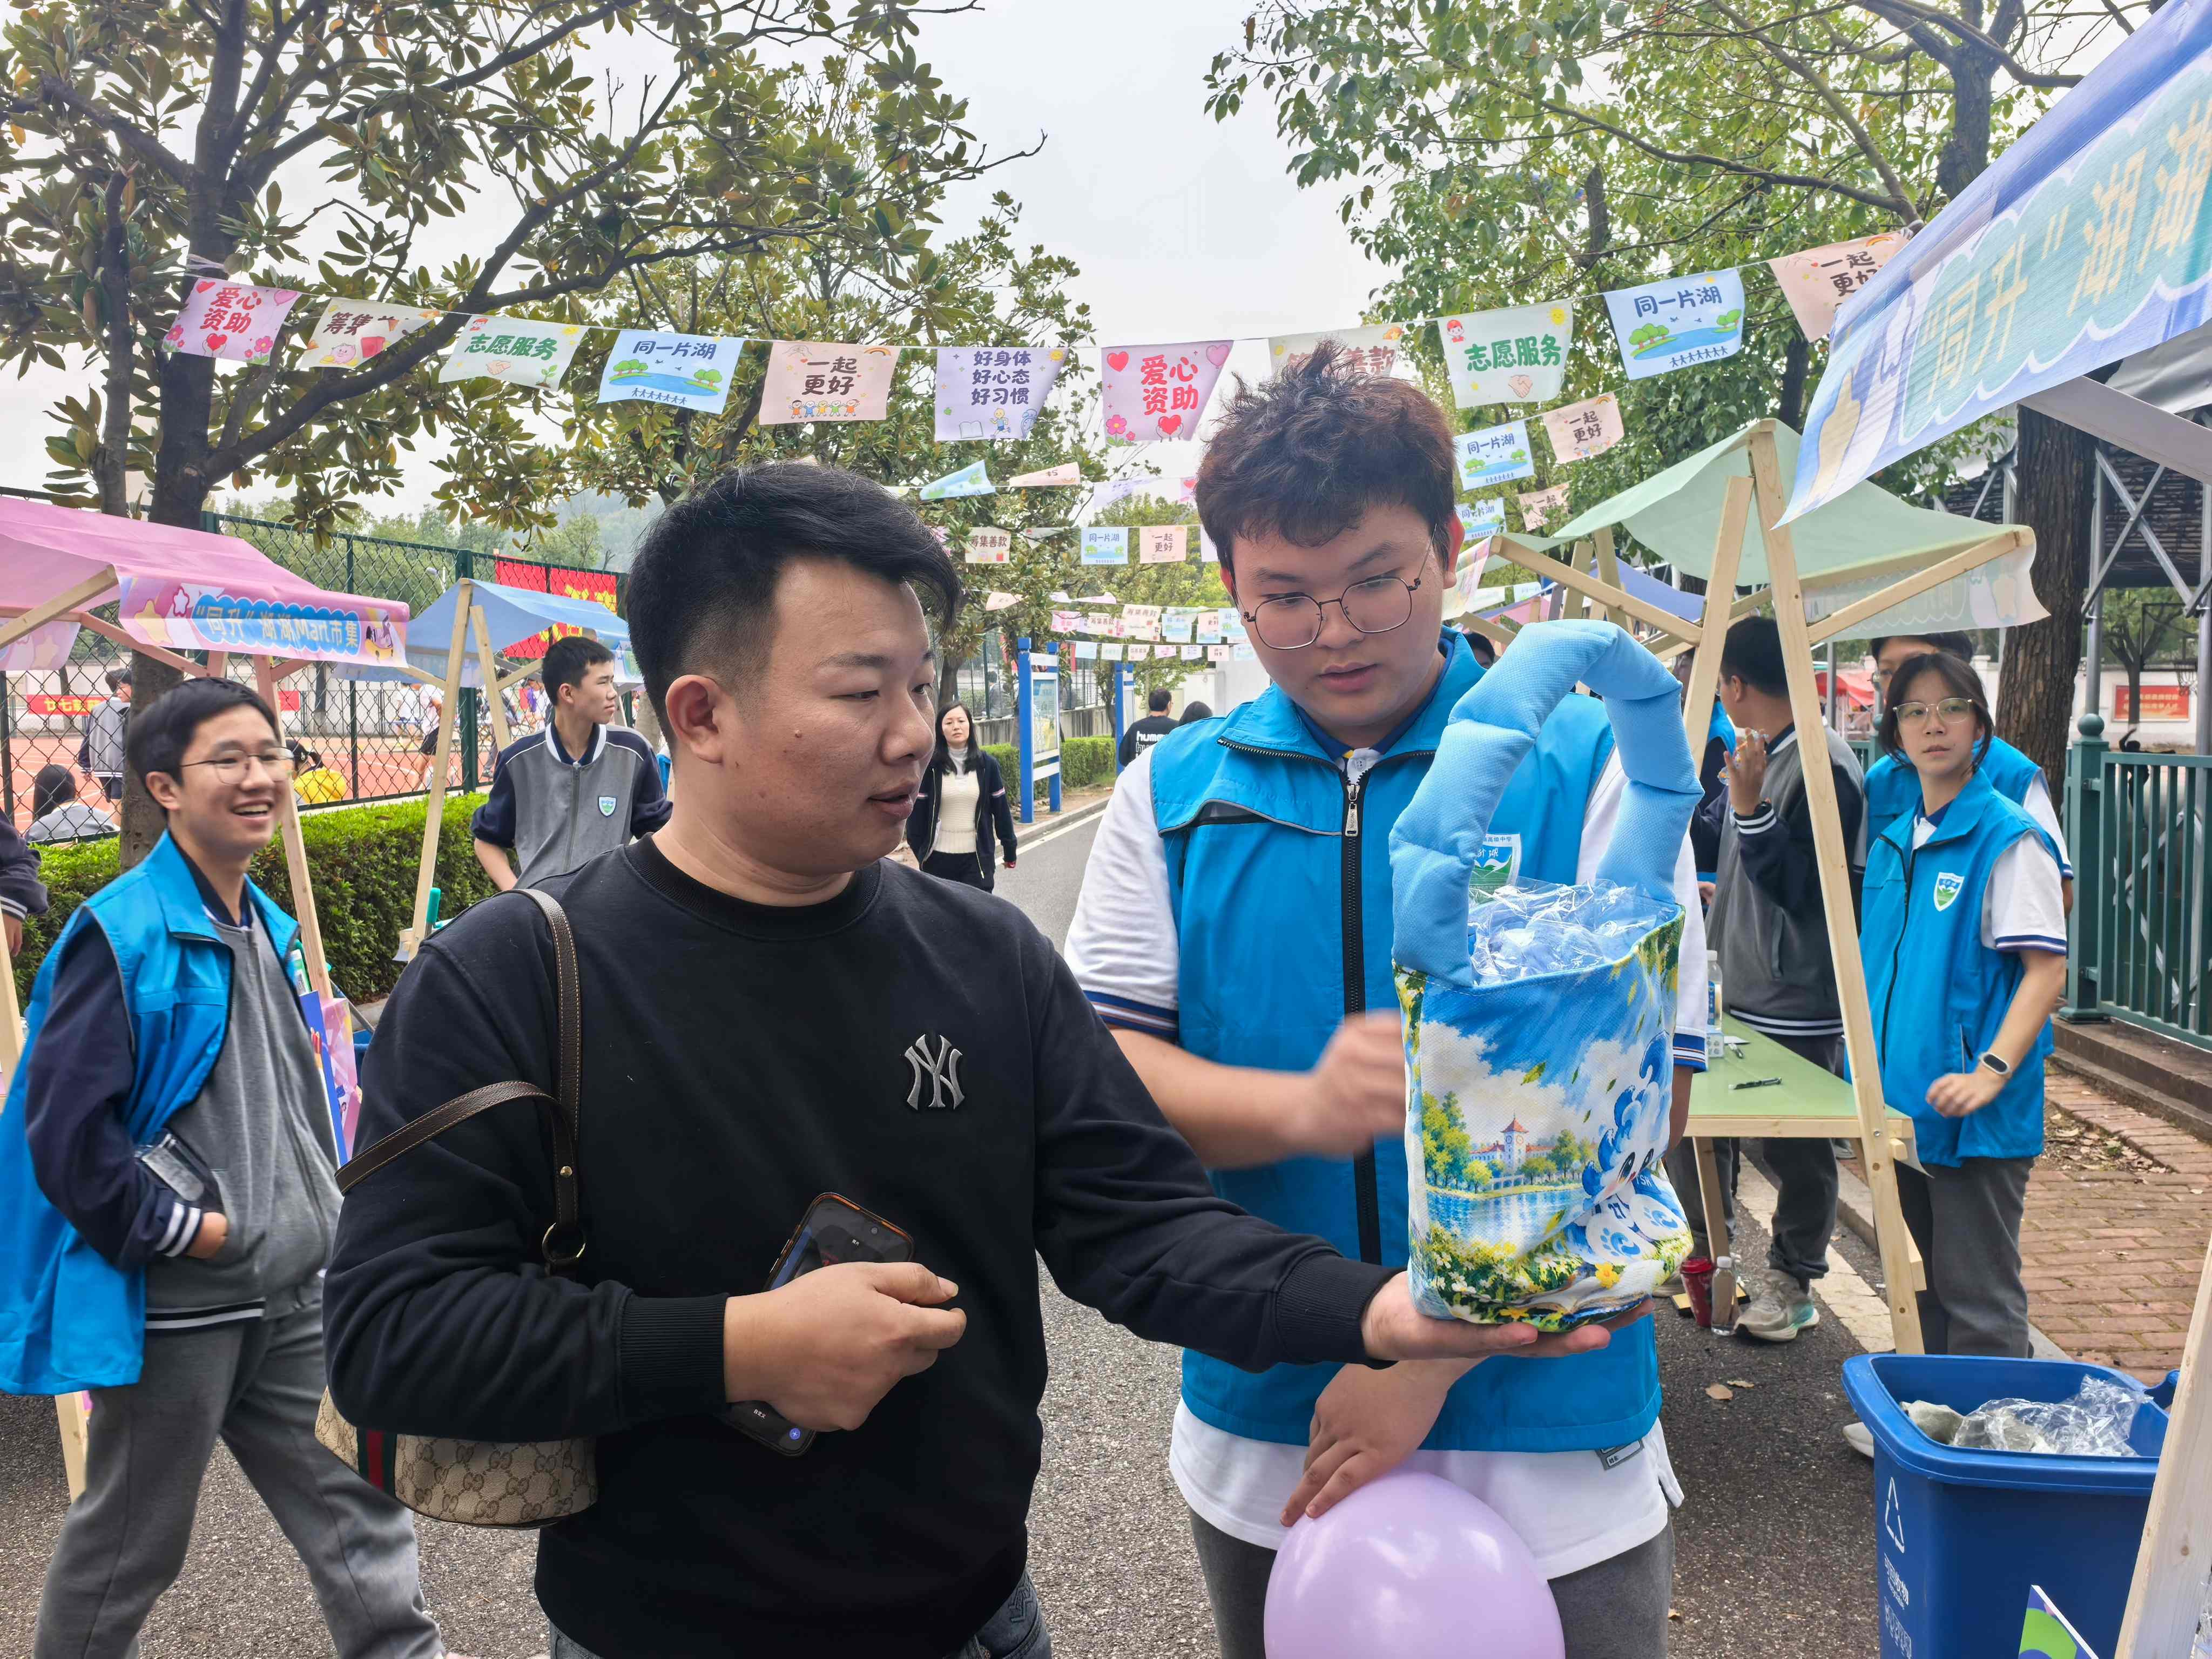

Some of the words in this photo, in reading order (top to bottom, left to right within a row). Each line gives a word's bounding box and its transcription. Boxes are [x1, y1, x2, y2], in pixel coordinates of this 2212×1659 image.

[1820, 251, 1876, 269] 一起
[211, 287, 262, 307] 爱心
[1634, 286, 1722, 317] 同一片湖
[199, 308, 252, 333] 资助
[323, 312, 396, 335] 筹集
[464, 333, 558, 360] 志愿服务
[632, 340, 717, 360] 同一片湖
[1464, 333, 1562, 372] 志愿服务
[807, 356, 858, 374] 一起
[973, 350, 1031, 367] 好身体
[1287, 345, 1395, 374] 善款
[972, 368, 1031, 385] 好心态
[1141, 355, 1199, 386] 爱心
[801, 375, 855, 396] 更好
[971, 387, 1030, 406] 好习惯
[1142, 387, 1199, 416] 资助
[1569, 410, 1599, 427] 一起
[1572, 423, 1602, 443] 更好
[1467, 433, 1515, 455] 同一片湖
[1089, 533, 1120, 542] 同一片湖
[1155, 533, 1174, 541] 一起
[1155, 542, 1174, 552] 更好
[904, 1034, 965, 1111] NY
